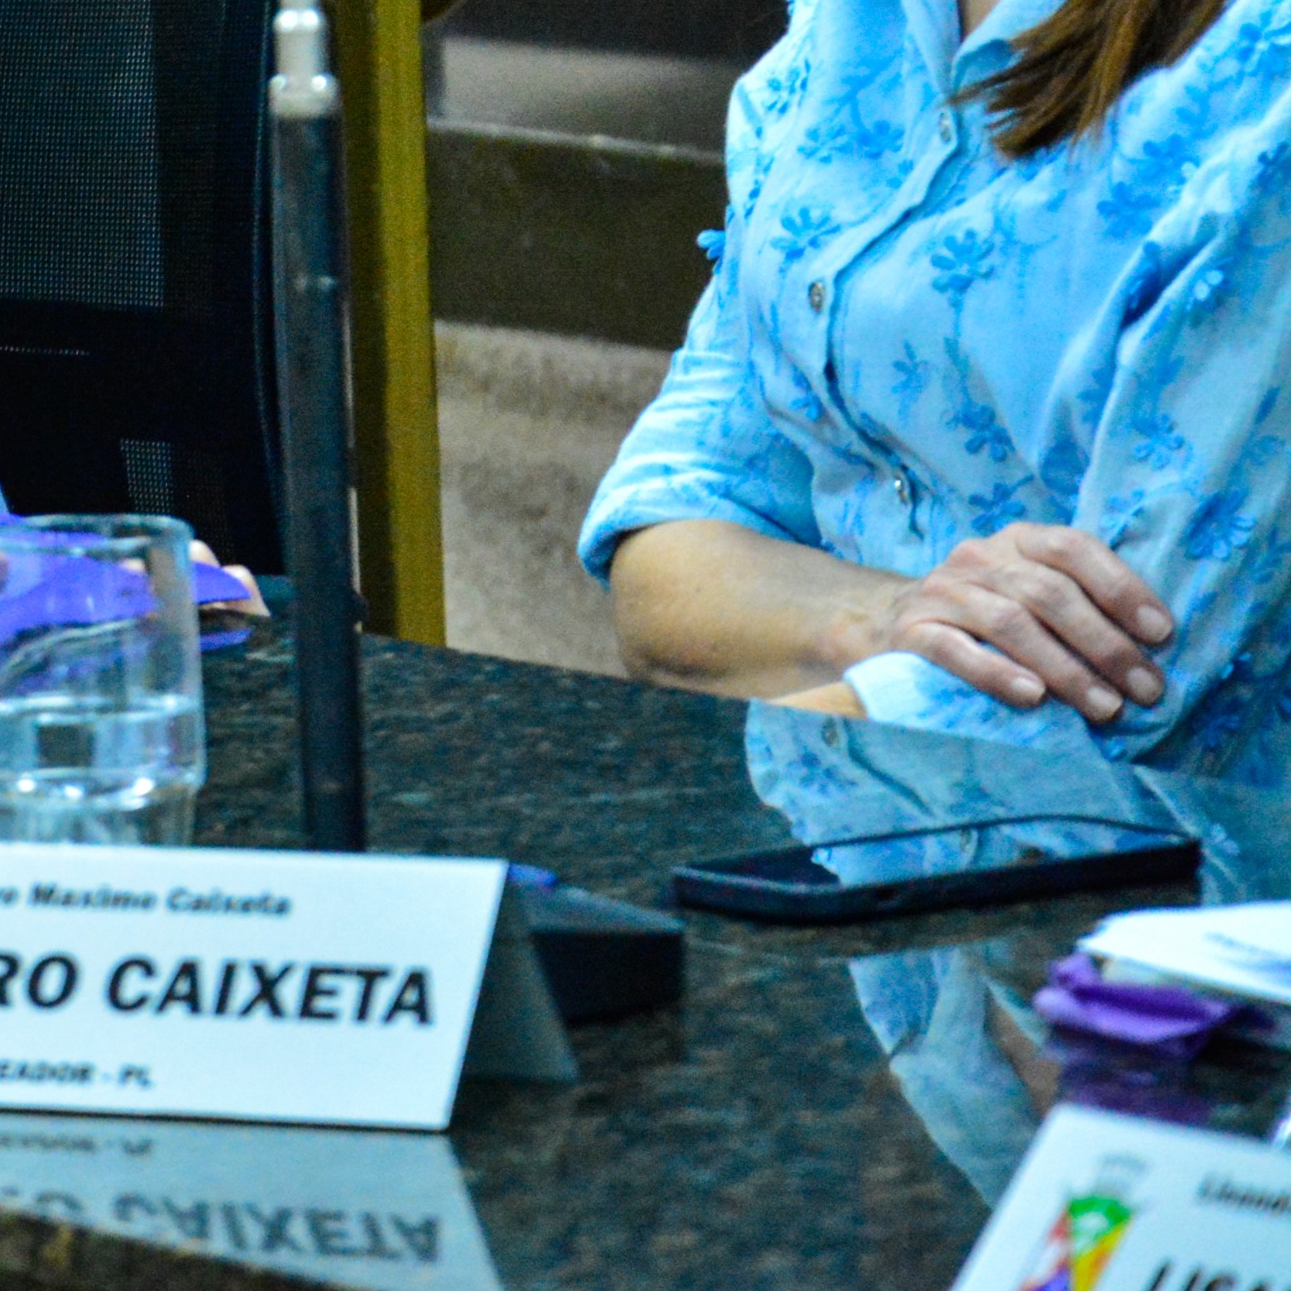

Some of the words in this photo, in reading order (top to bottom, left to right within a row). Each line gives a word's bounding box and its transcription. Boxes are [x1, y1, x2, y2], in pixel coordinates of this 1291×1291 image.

[27, 881, 156, 909] Maximo
[165, 887, 291, 916] Caixeta
[106, 954, 433, 1025] CAIXETA
[117, 1064, 152, 1088] PL
